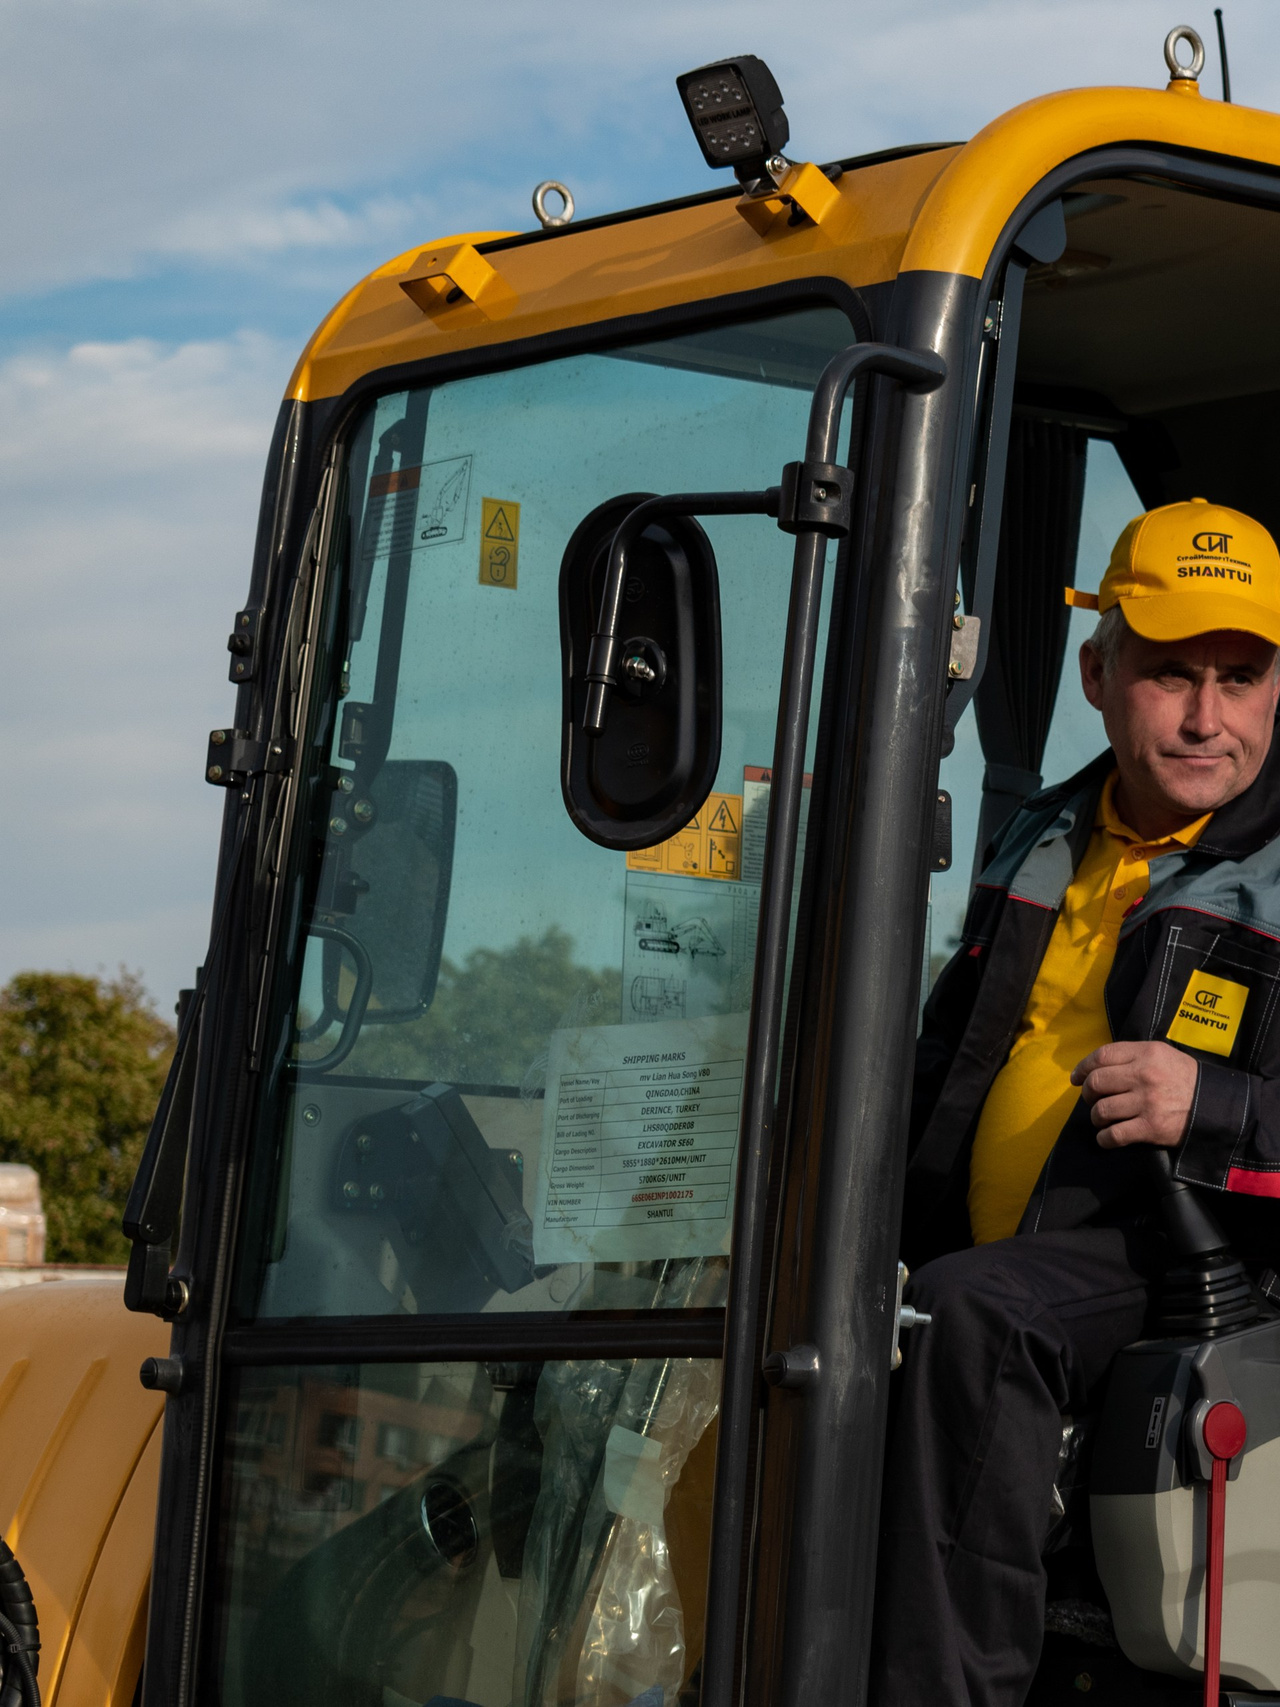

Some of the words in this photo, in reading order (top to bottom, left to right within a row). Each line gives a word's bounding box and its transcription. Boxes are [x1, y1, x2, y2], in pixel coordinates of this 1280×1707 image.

[709, 111, 731, 123] WORK
[732, 107, 750, 118] LAMP
[1192, 532, 1233, 554] СИТ
[1177, 566, 1252, 585] SHANTUI
[1195, 990, 1223, 1009] СИТ
[1178, 1010, 1228, 1031] SHANTUI
[622, 1054, 659, 1064] SHIPPING
[661, 1052, 686, 1062] MARKS
[652, 1072, 666, 1081] Lian
[668, 1072, 680, 1080] Hua
[682, 1071, 697, 1080] Song
[698, 1068, 710, 1077] V80
[646, 1086, 700, 1099] QINGDAO,CHINA
[641, 1105, 673, 1115] DERINCE,
[675, 1104, 701, 1113] TURKEY
[642, 1121, 694, 1132] LHS80QDDER08
[638, 1140, 676, 1149] EXCAVATOR
[677, 1138, 694, 1147] SE60
[571, 1147, 596, 1155] Description
[639, 1173, 686, 1184] 5700KGS/UNIT
[647, 1209, 674, 1218] SHANTUI
